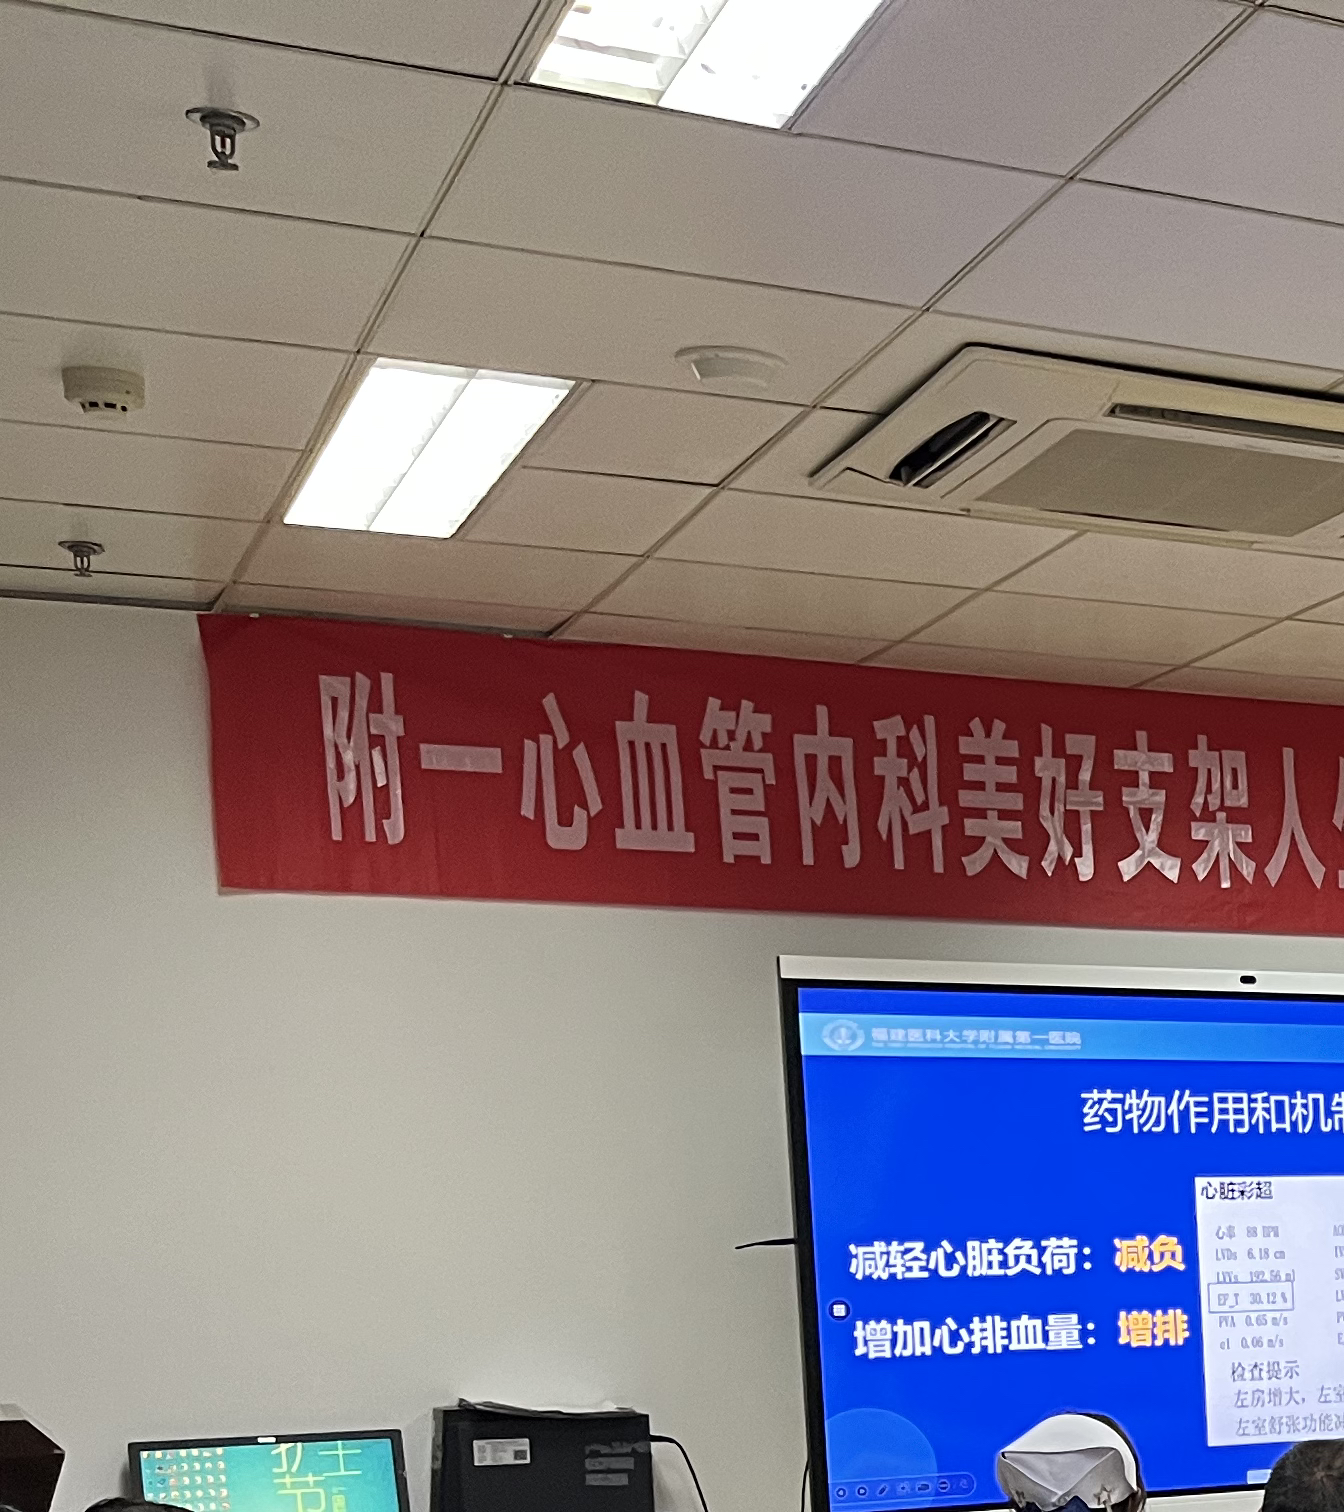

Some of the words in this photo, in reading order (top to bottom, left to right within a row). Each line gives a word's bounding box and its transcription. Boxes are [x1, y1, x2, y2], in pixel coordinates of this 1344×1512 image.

[1201, 1181, 1273, 1200] 心脏彩超
[1231, 1359, 1300, 1382] 检查提示
